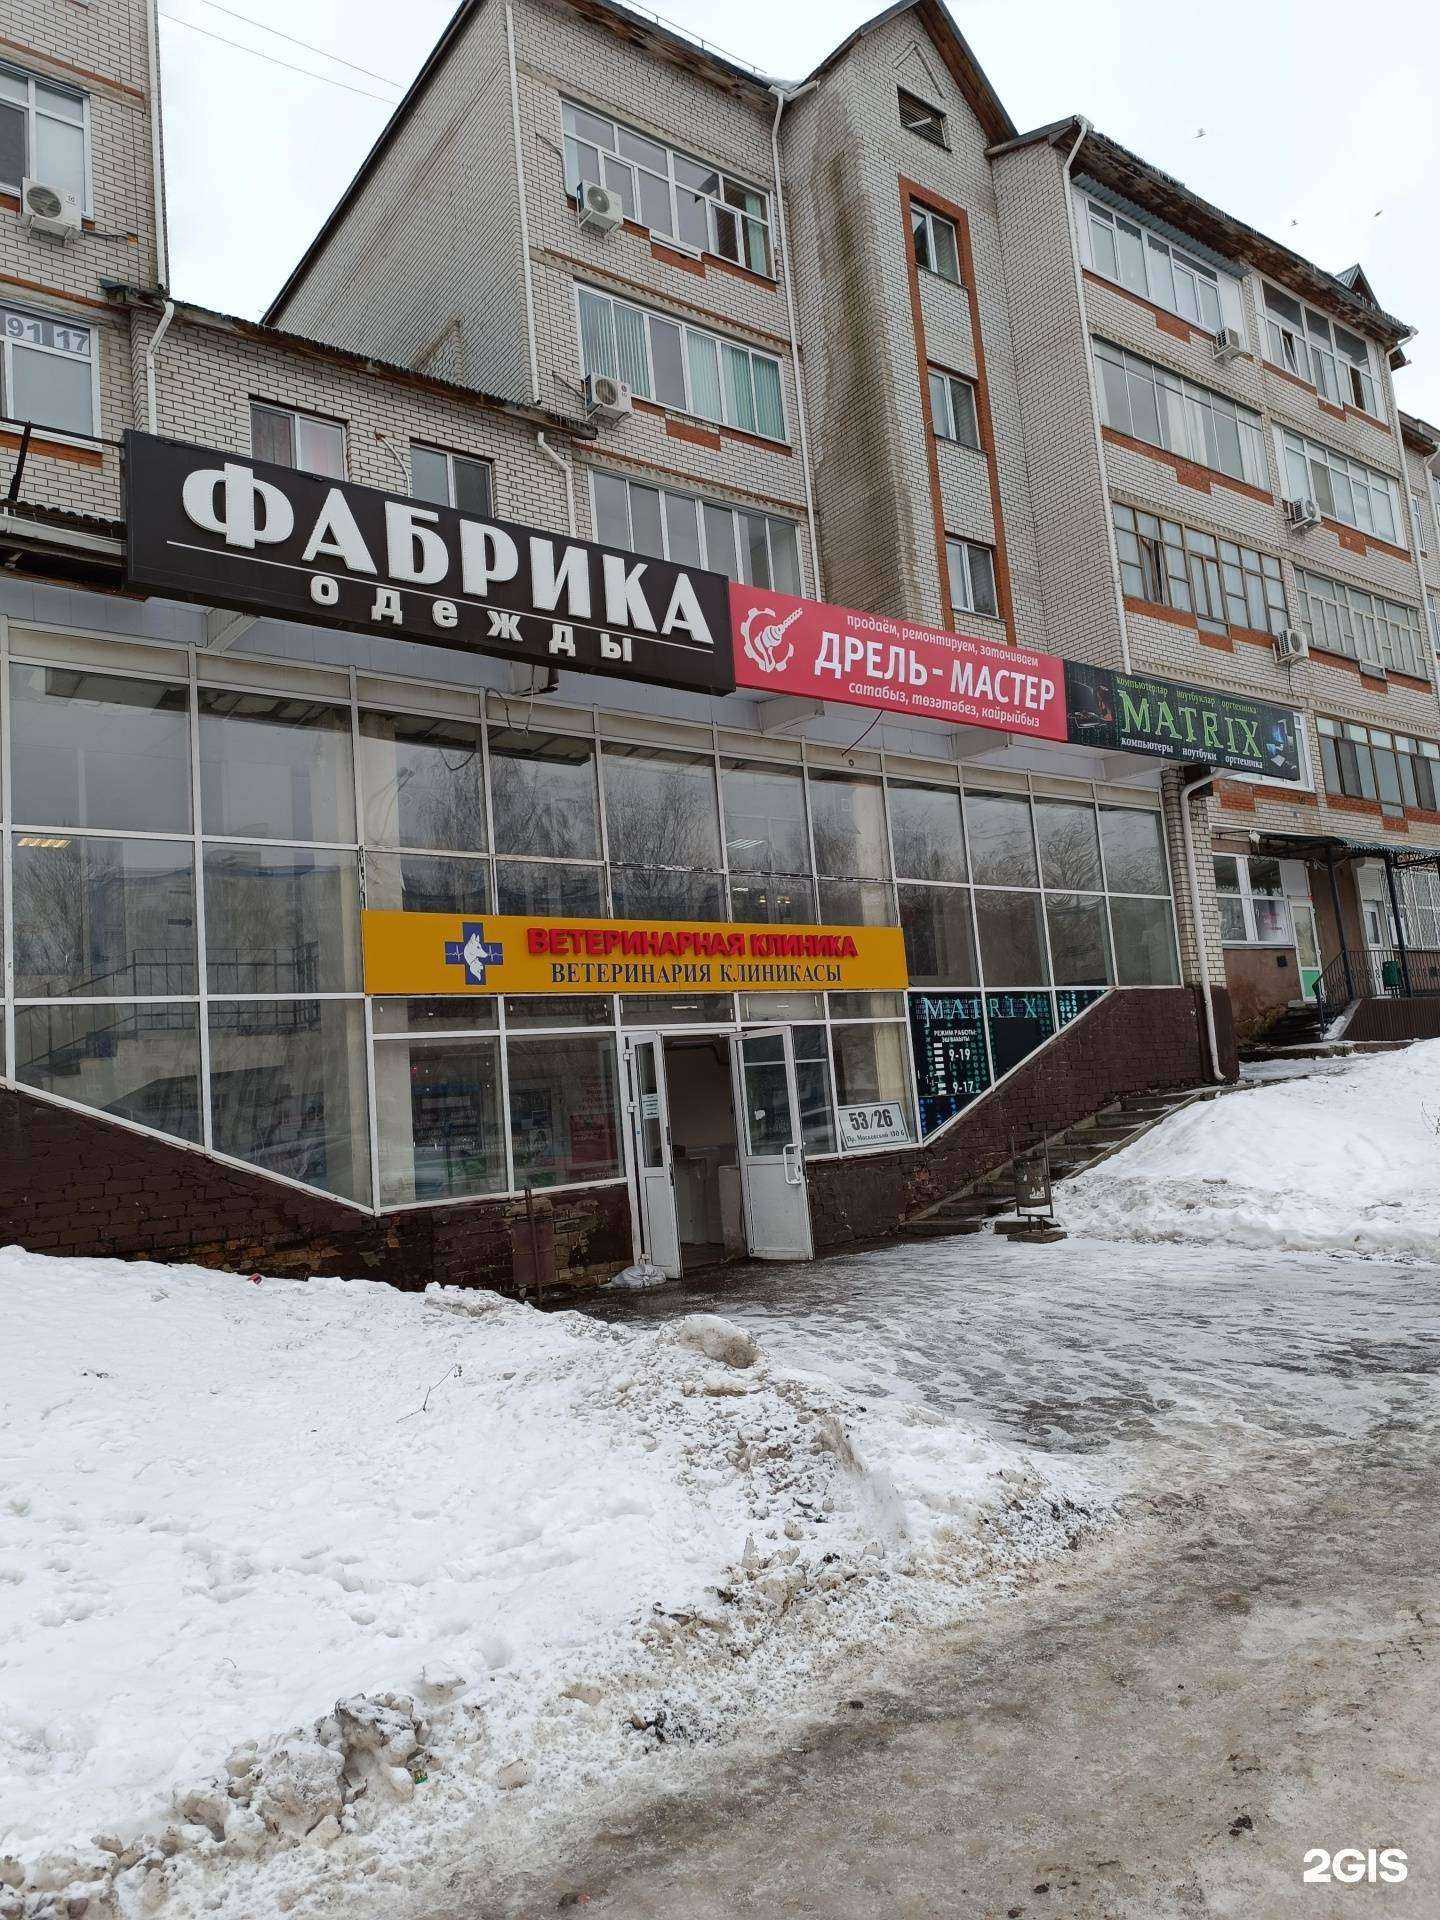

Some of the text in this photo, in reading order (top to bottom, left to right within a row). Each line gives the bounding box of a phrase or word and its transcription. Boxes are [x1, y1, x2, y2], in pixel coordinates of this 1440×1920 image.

[56, 330, 88, 353] 17
[182, 462, 714, 645] ФАБРИКА
[847, 615, 899, 641] продаём,
[902, 628, 978, 655] ремонтируем,
[950, 659, 1054, 711] МАСТЕР
[848, 682, 908, 704] сатабыз,
[981, 706, 1040, 728] кайрыйбыз
[1117, 689, 1263, 758] MATRIX
[1121, 737, 1263, 769] компьютеры ноутбуки оргтехника
[527, 927, 859, 958] ВЕТЕРИНАРНАЯ КЛИНИКА
[551, 962, 842, 985] ВЕТЕРИНАРИЯ КЛИНИКАСЫ
[920, 997, 1038, 1027] MATRIX
[948, 1048, 971, 1061] 9-19
[952, 1081, 974, 1093] 9-17
[849, 1108, 893, 1131] 53/26
